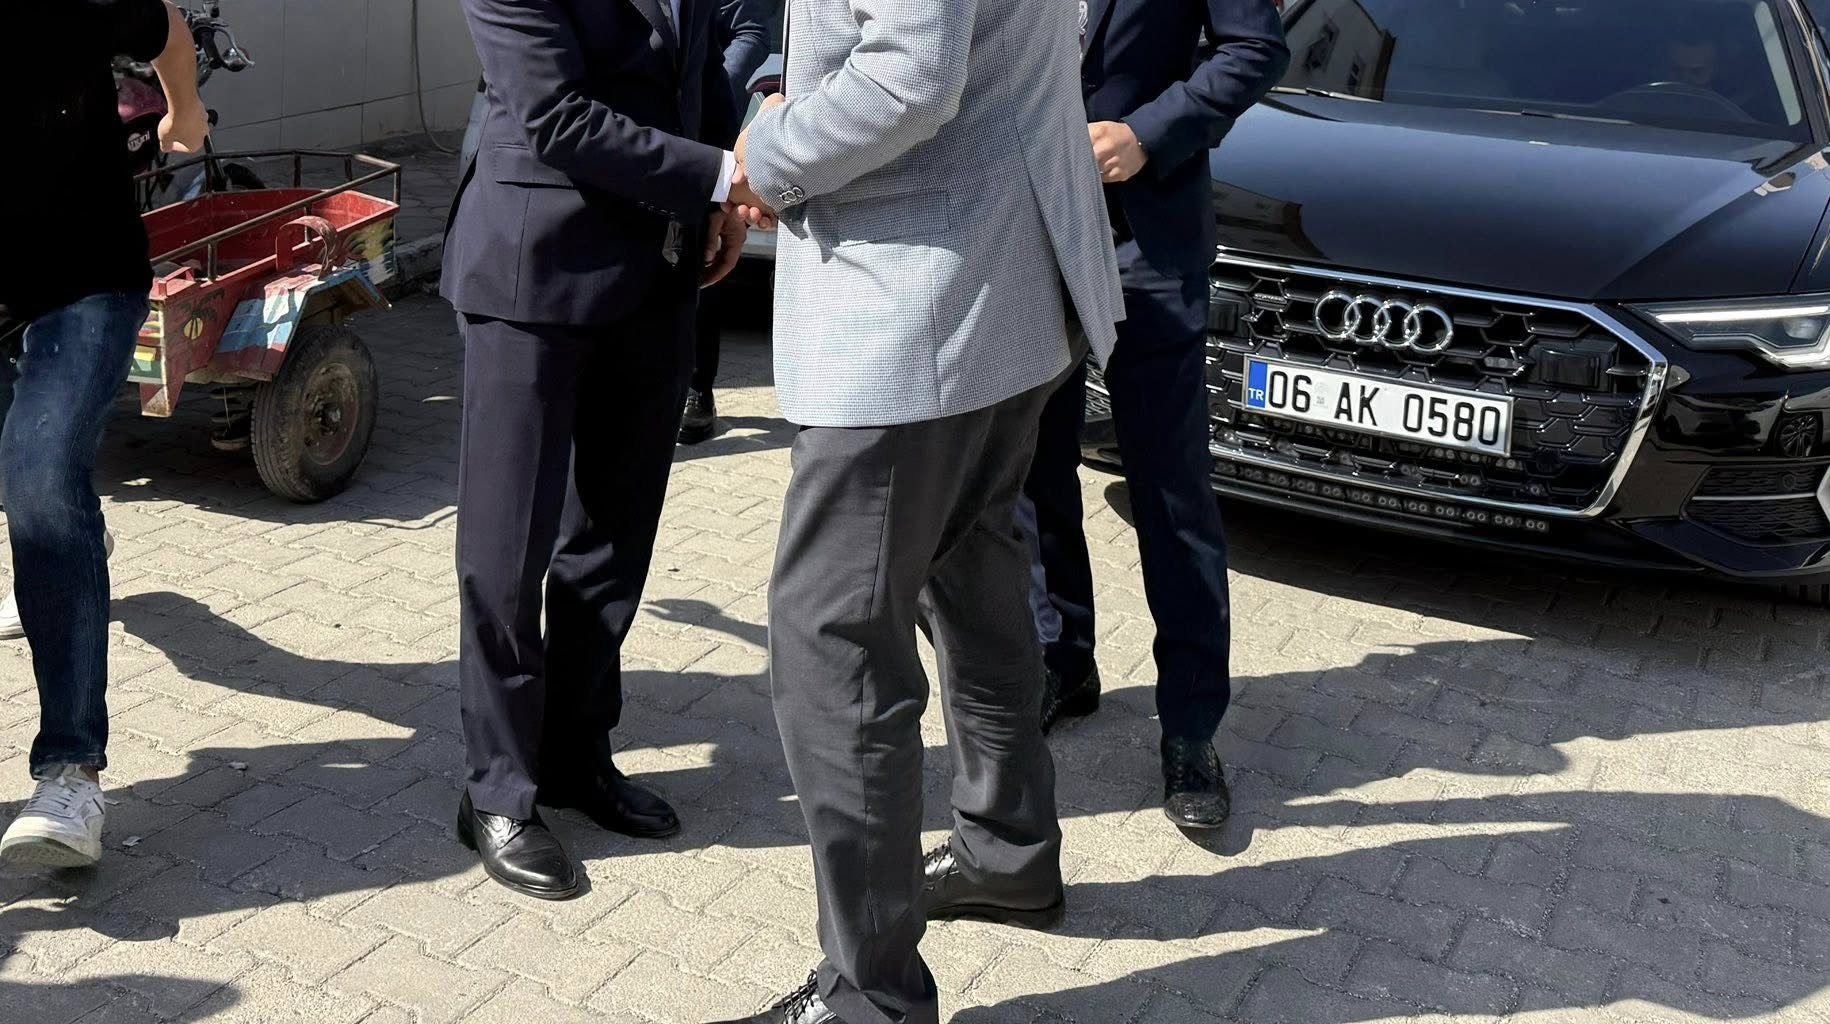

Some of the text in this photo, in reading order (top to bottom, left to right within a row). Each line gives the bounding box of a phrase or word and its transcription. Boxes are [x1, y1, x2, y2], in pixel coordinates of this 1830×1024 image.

[1249, 370, 1500, 446] TR 06 AK 0580
